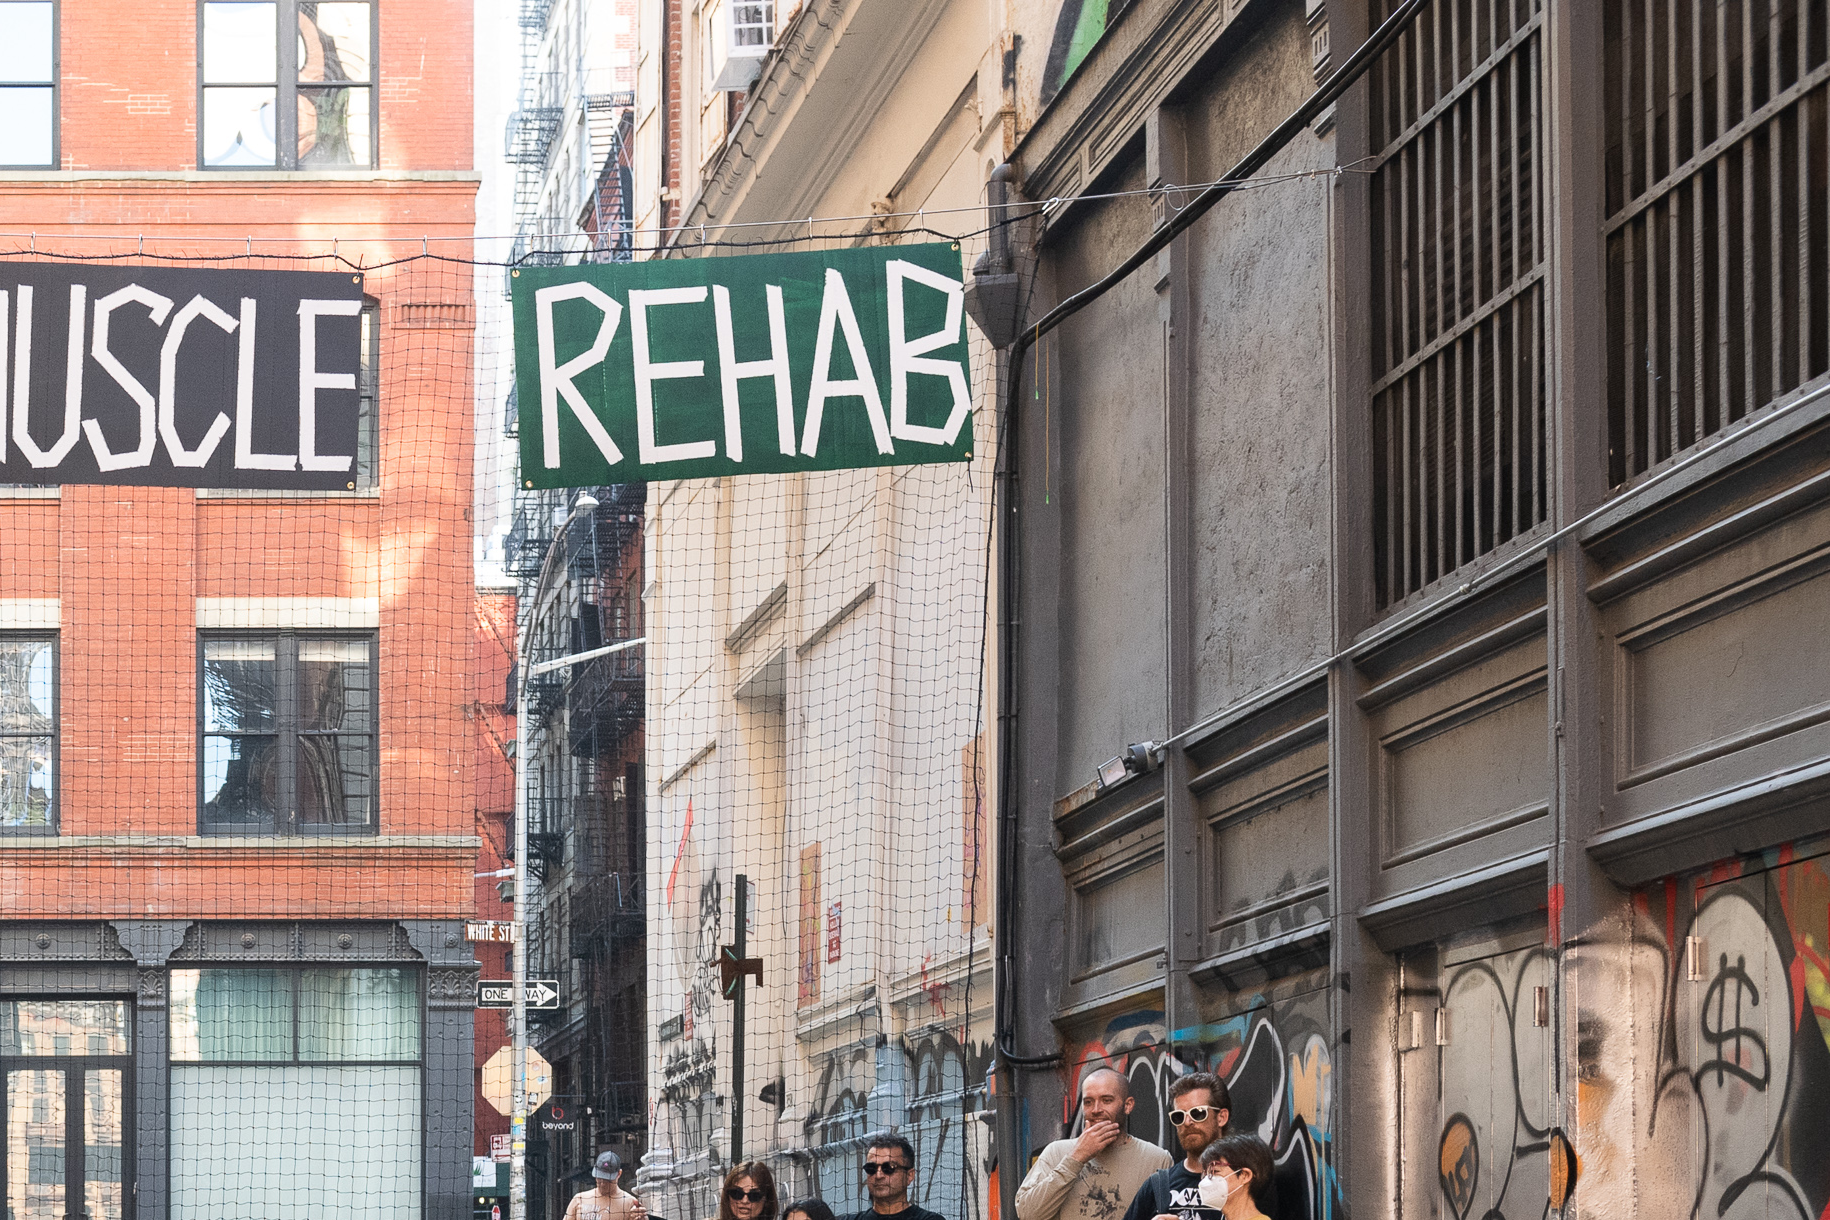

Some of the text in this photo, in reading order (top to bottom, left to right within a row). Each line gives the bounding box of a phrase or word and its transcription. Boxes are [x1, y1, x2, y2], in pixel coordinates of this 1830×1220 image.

[535, 258, 973, 470] REHAB
[467, 924, 510, 942] WHITE ST
[484, 989, 508, 1000] ONE
[542, 1120, 575, 1132] beyond
